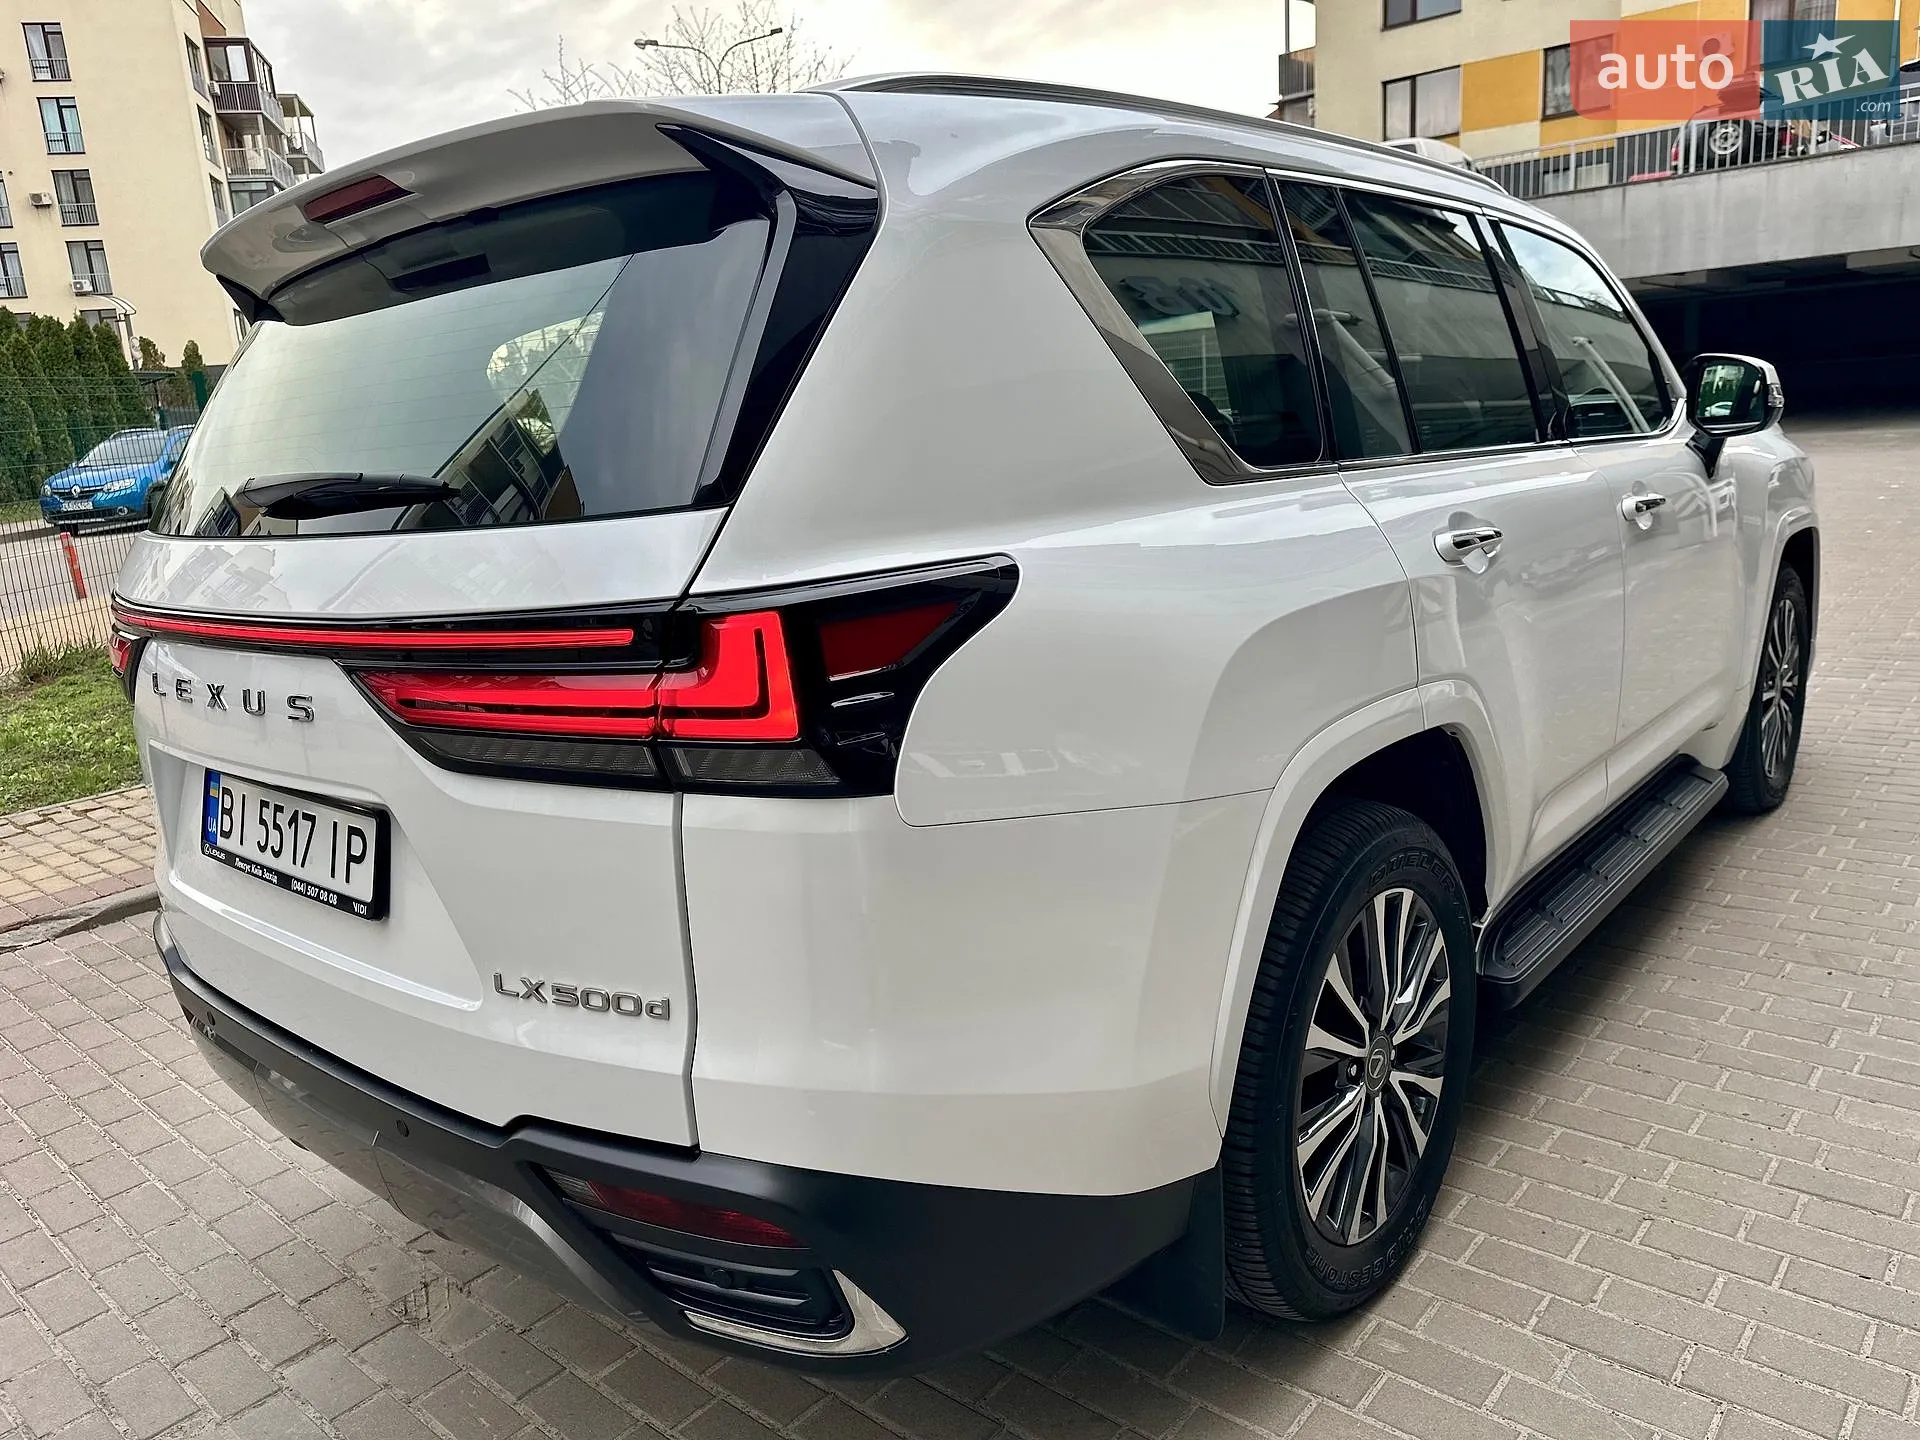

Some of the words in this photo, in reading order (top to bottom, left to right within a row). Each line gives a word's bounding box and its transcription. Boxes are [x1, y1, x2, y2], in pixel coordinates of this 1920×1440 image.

[151, 672, 315, 722] LEXUS
[207, 816, 217, 834] UA
[219, 786, 246, 846] BI
[257, 798, 317, 868] 5517
[330, 820, 368, 884] IP
[291, 878, 307, 895] (044)
[306, 885, 319, 898] 507
[319, 889, 328, 902] 08
[328, 893, 338, 905] 08
[352, 901, 368, 915] VIDI
